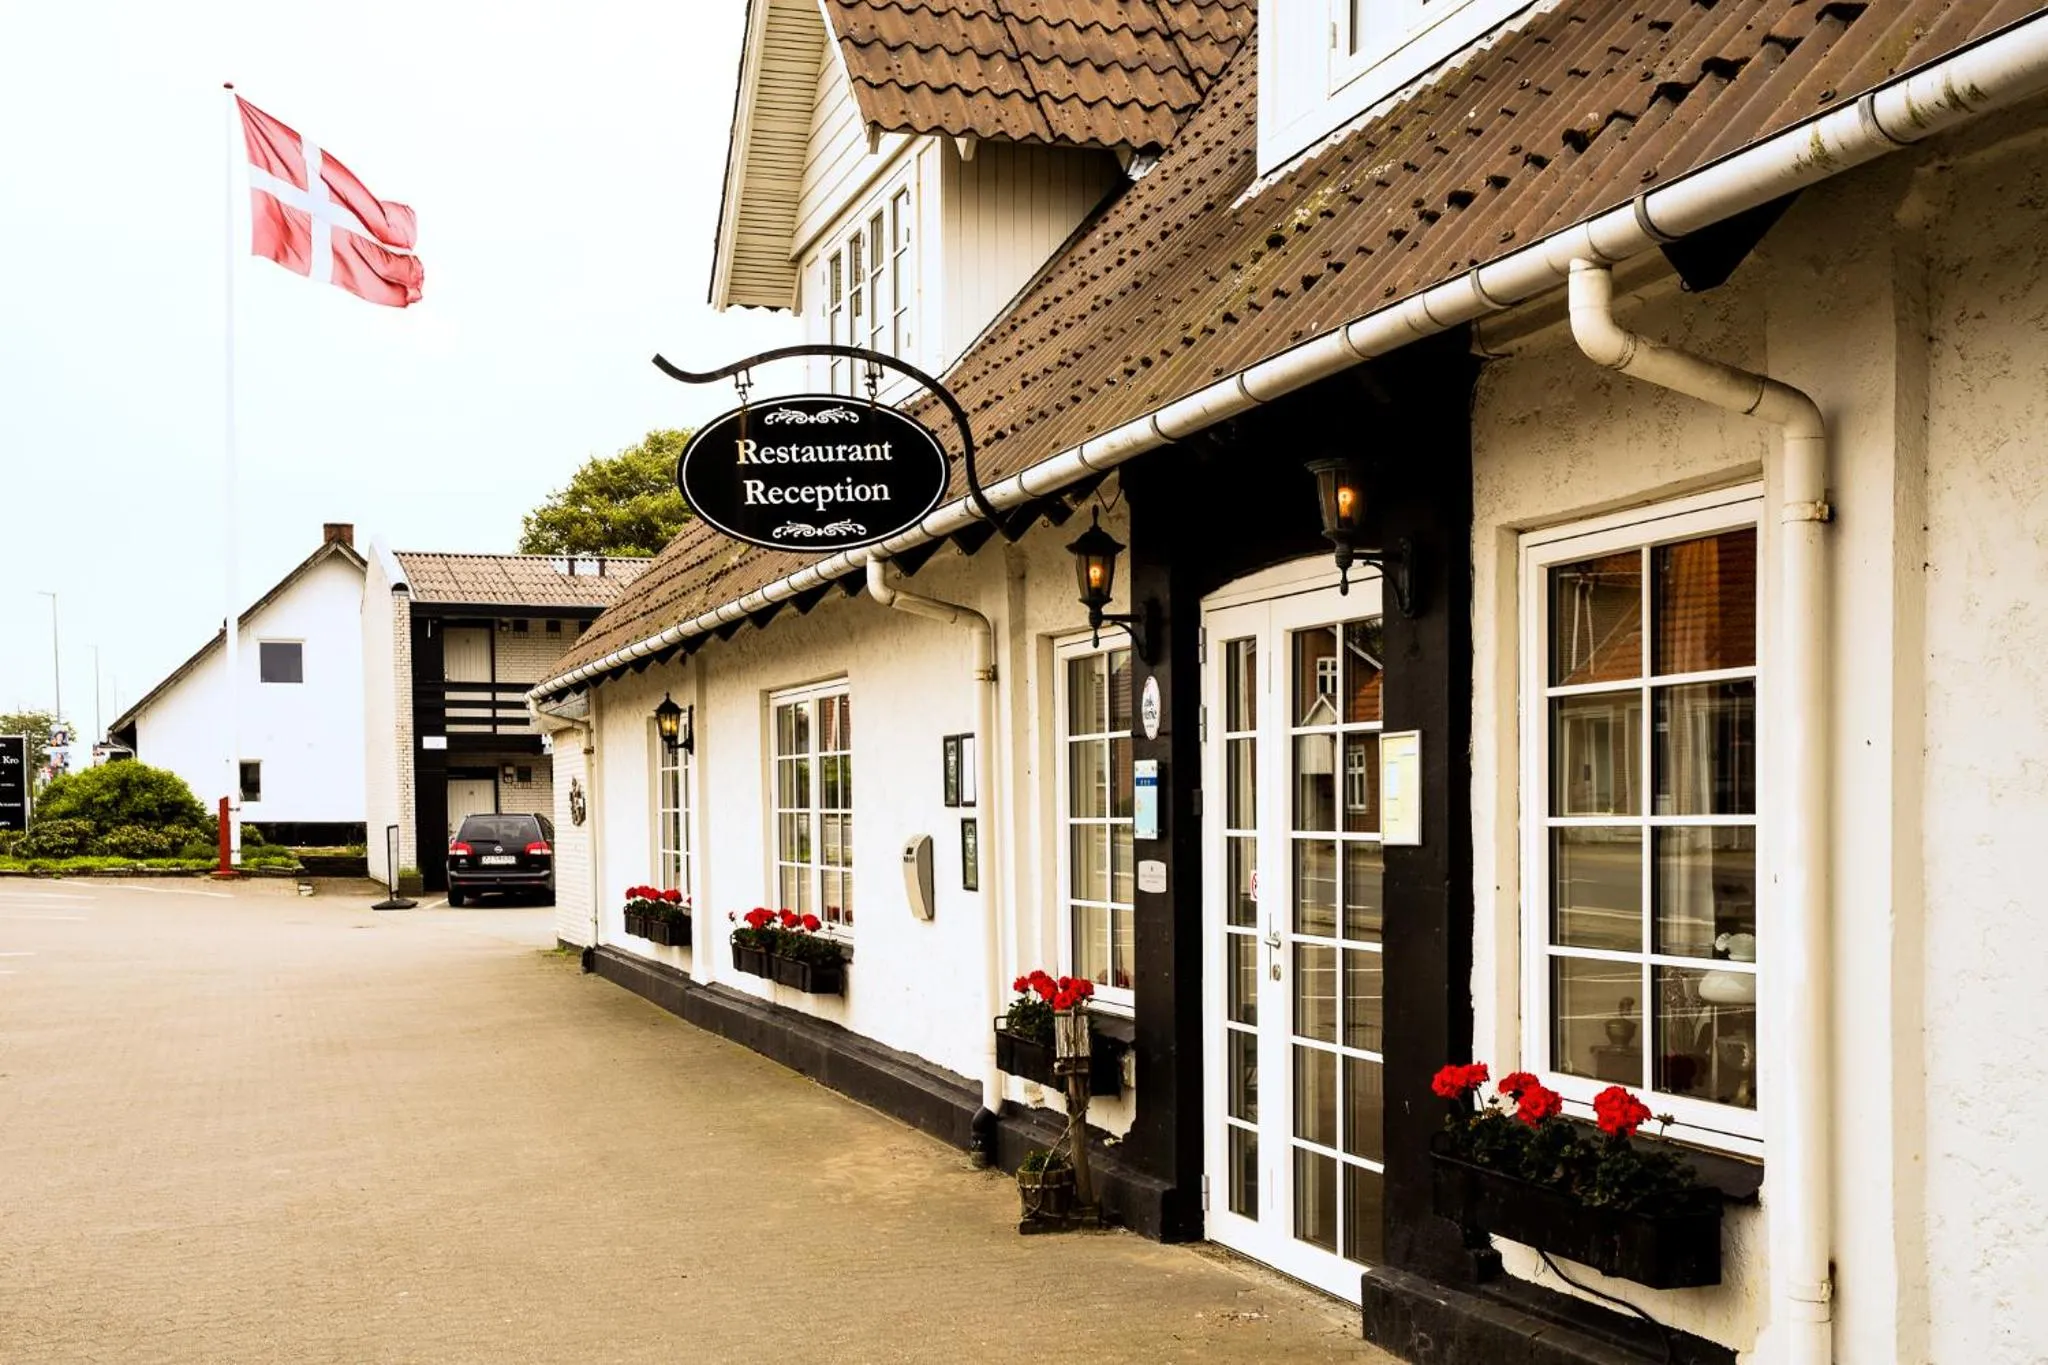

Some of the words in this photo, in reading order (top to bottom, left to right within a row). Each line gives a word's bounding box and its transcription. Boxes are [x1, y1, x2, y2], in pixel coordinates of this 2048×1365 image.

[735, 438, 893, 465] Restaurant
[743, 476, 891, 512] Reception
[2, 755, 20, 765] Kro
